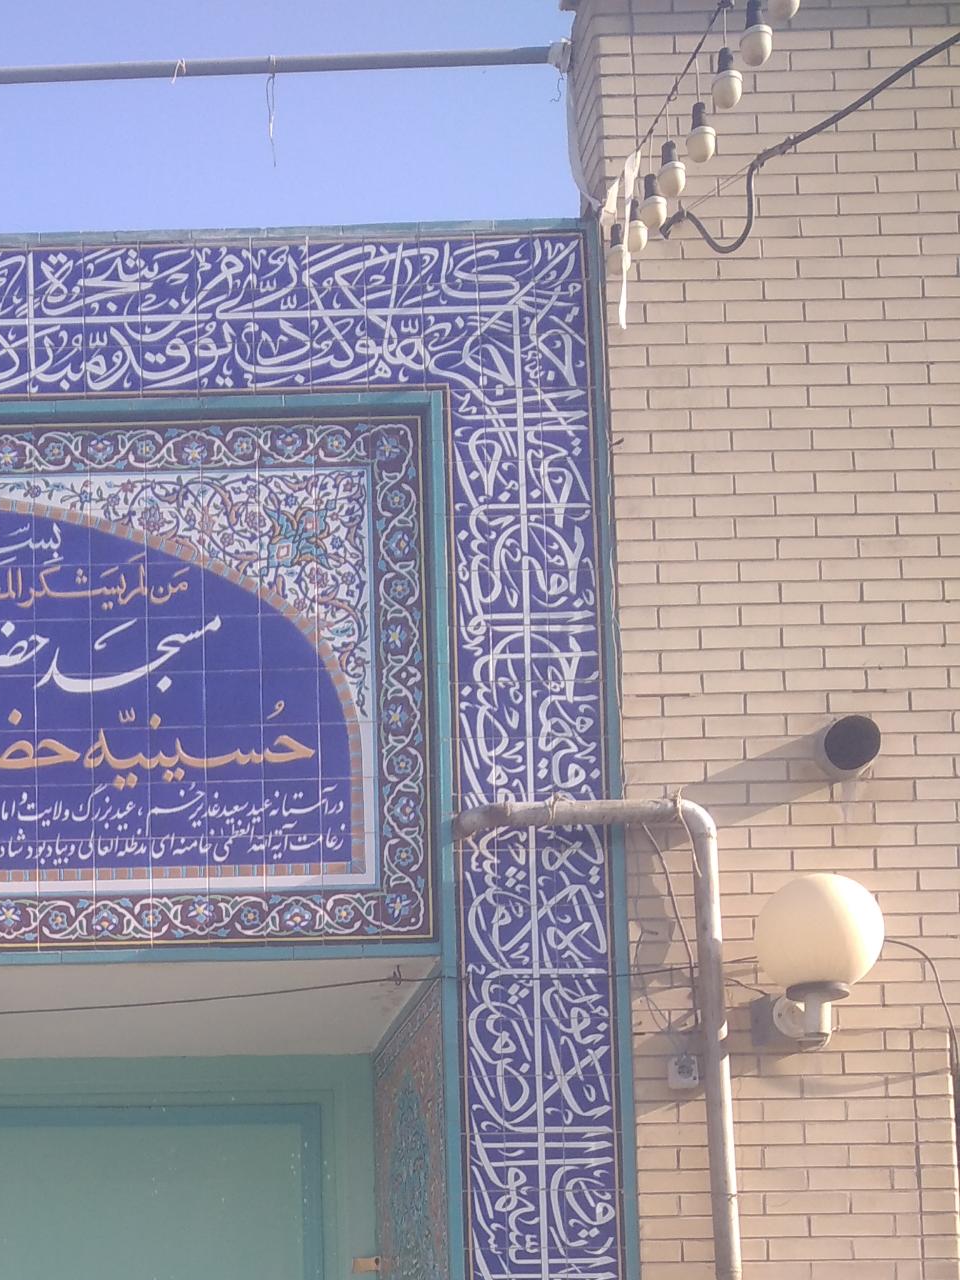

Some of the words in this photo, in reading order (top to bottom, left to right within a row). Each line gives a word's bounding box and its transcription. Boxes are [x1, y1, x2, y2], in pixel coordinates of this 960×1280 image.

[116, 557, 150, 606] لم
[149, 568, 189, 603] من
[36, 613, 223, 694] مسجد
